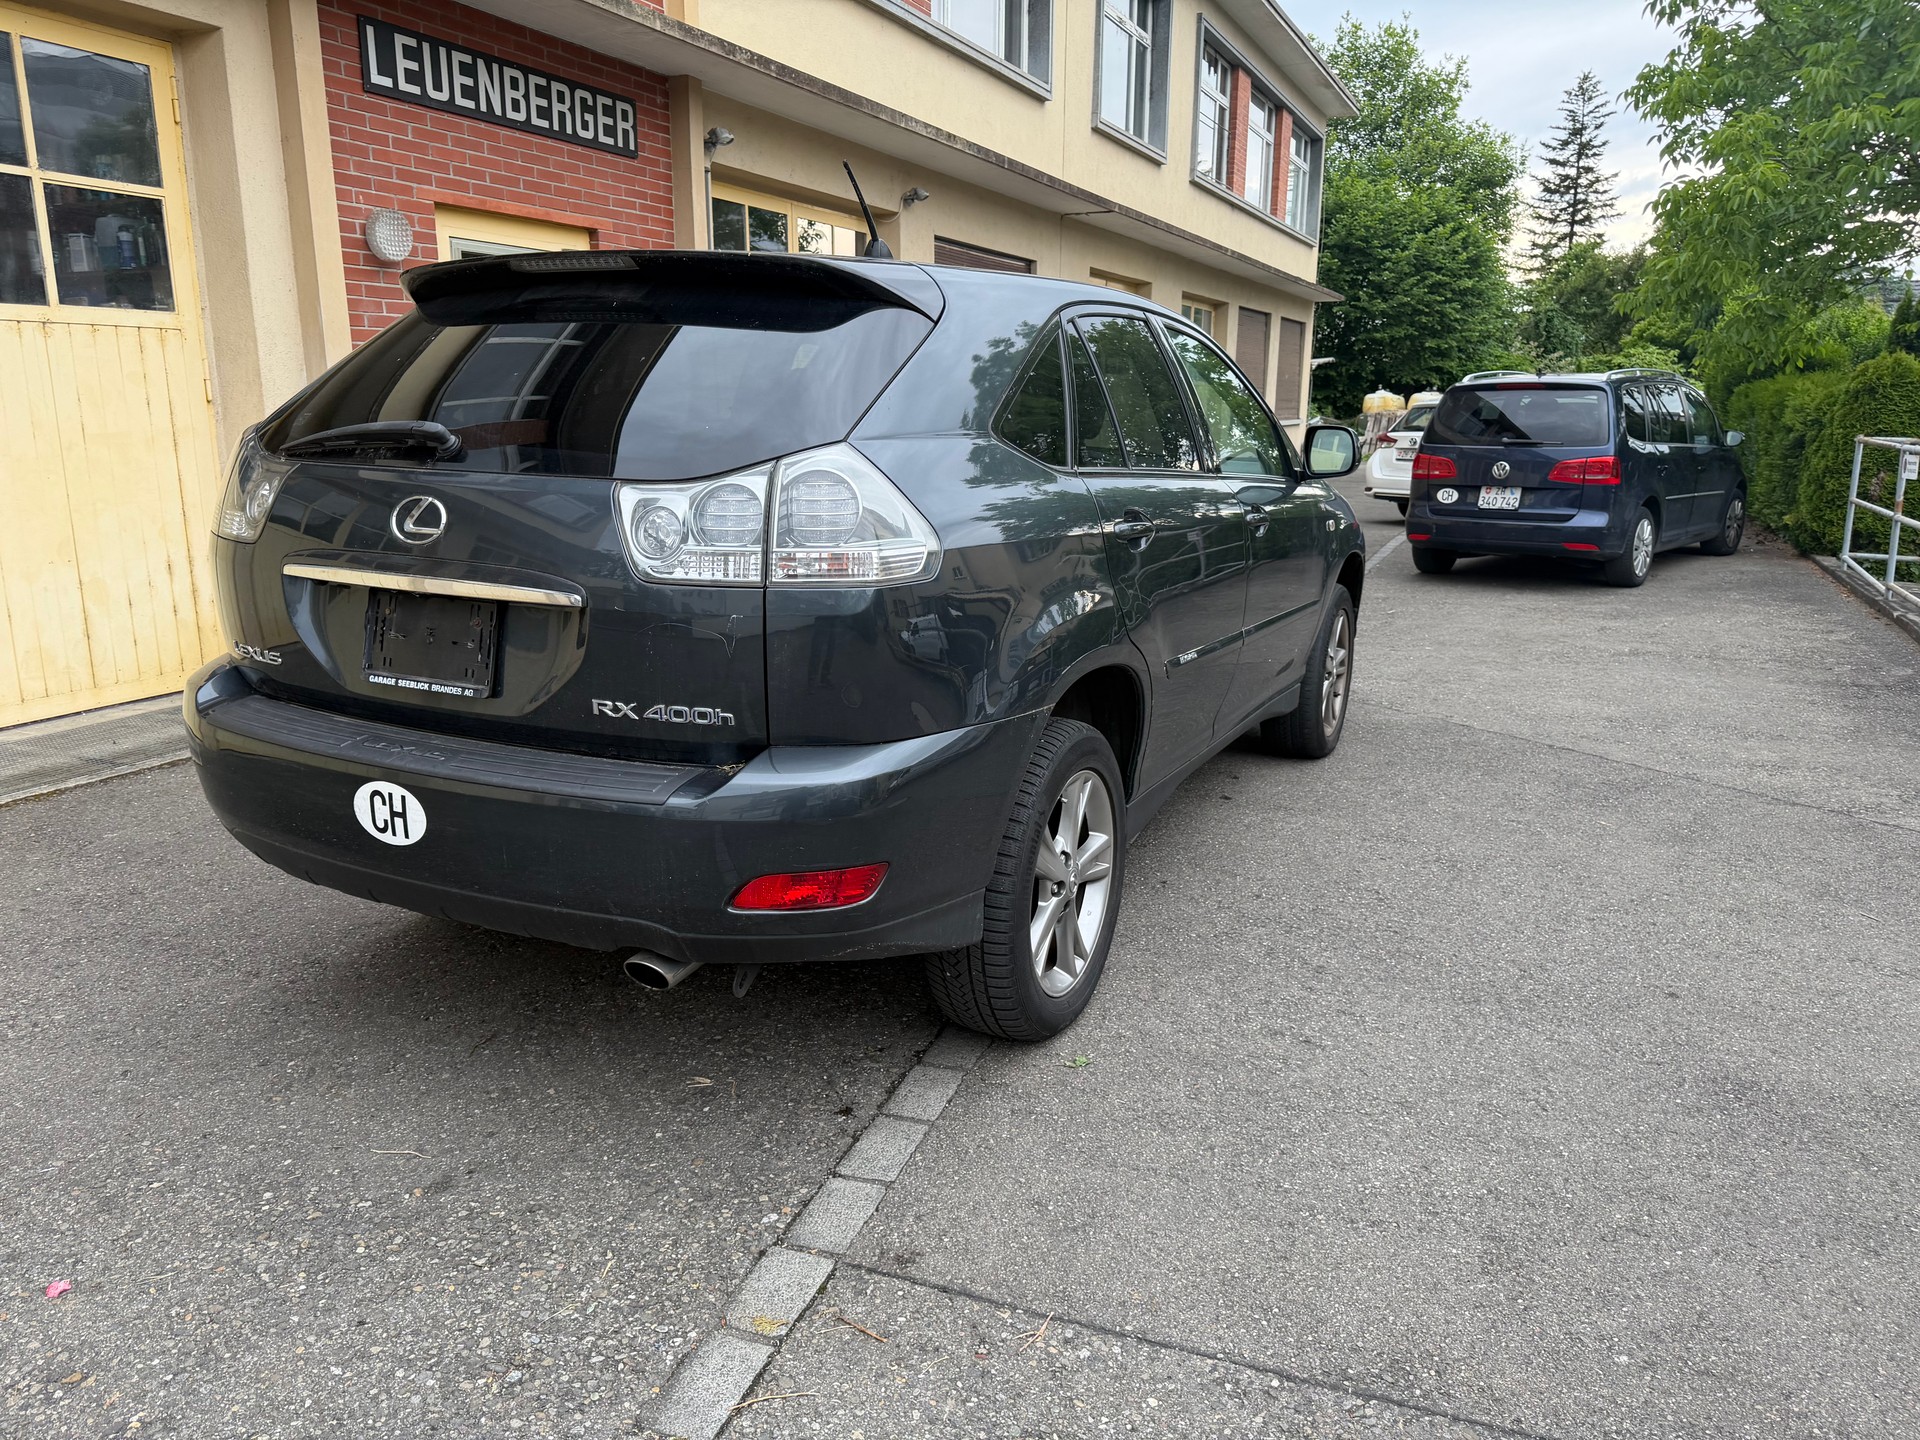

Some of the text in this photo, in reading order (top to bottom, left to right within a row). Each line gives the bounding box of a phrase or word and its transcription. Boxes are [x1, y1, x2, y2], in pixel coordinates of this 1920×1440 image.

[365, 25, 636, 151] LEUENBERGER
[1441, 490, 1454, 502] CH
[1480, 496, 1518, 508] 340 742
[1495, 487, 1506, 496] ZH
[233, 640, 282, 665] LEXUS
[369, 675, 474, 697] GARAGE SEEBLICK BRANDES AG
[592, 699, 735, 726] RX 400h
[369, 789, 410, 840] CH
